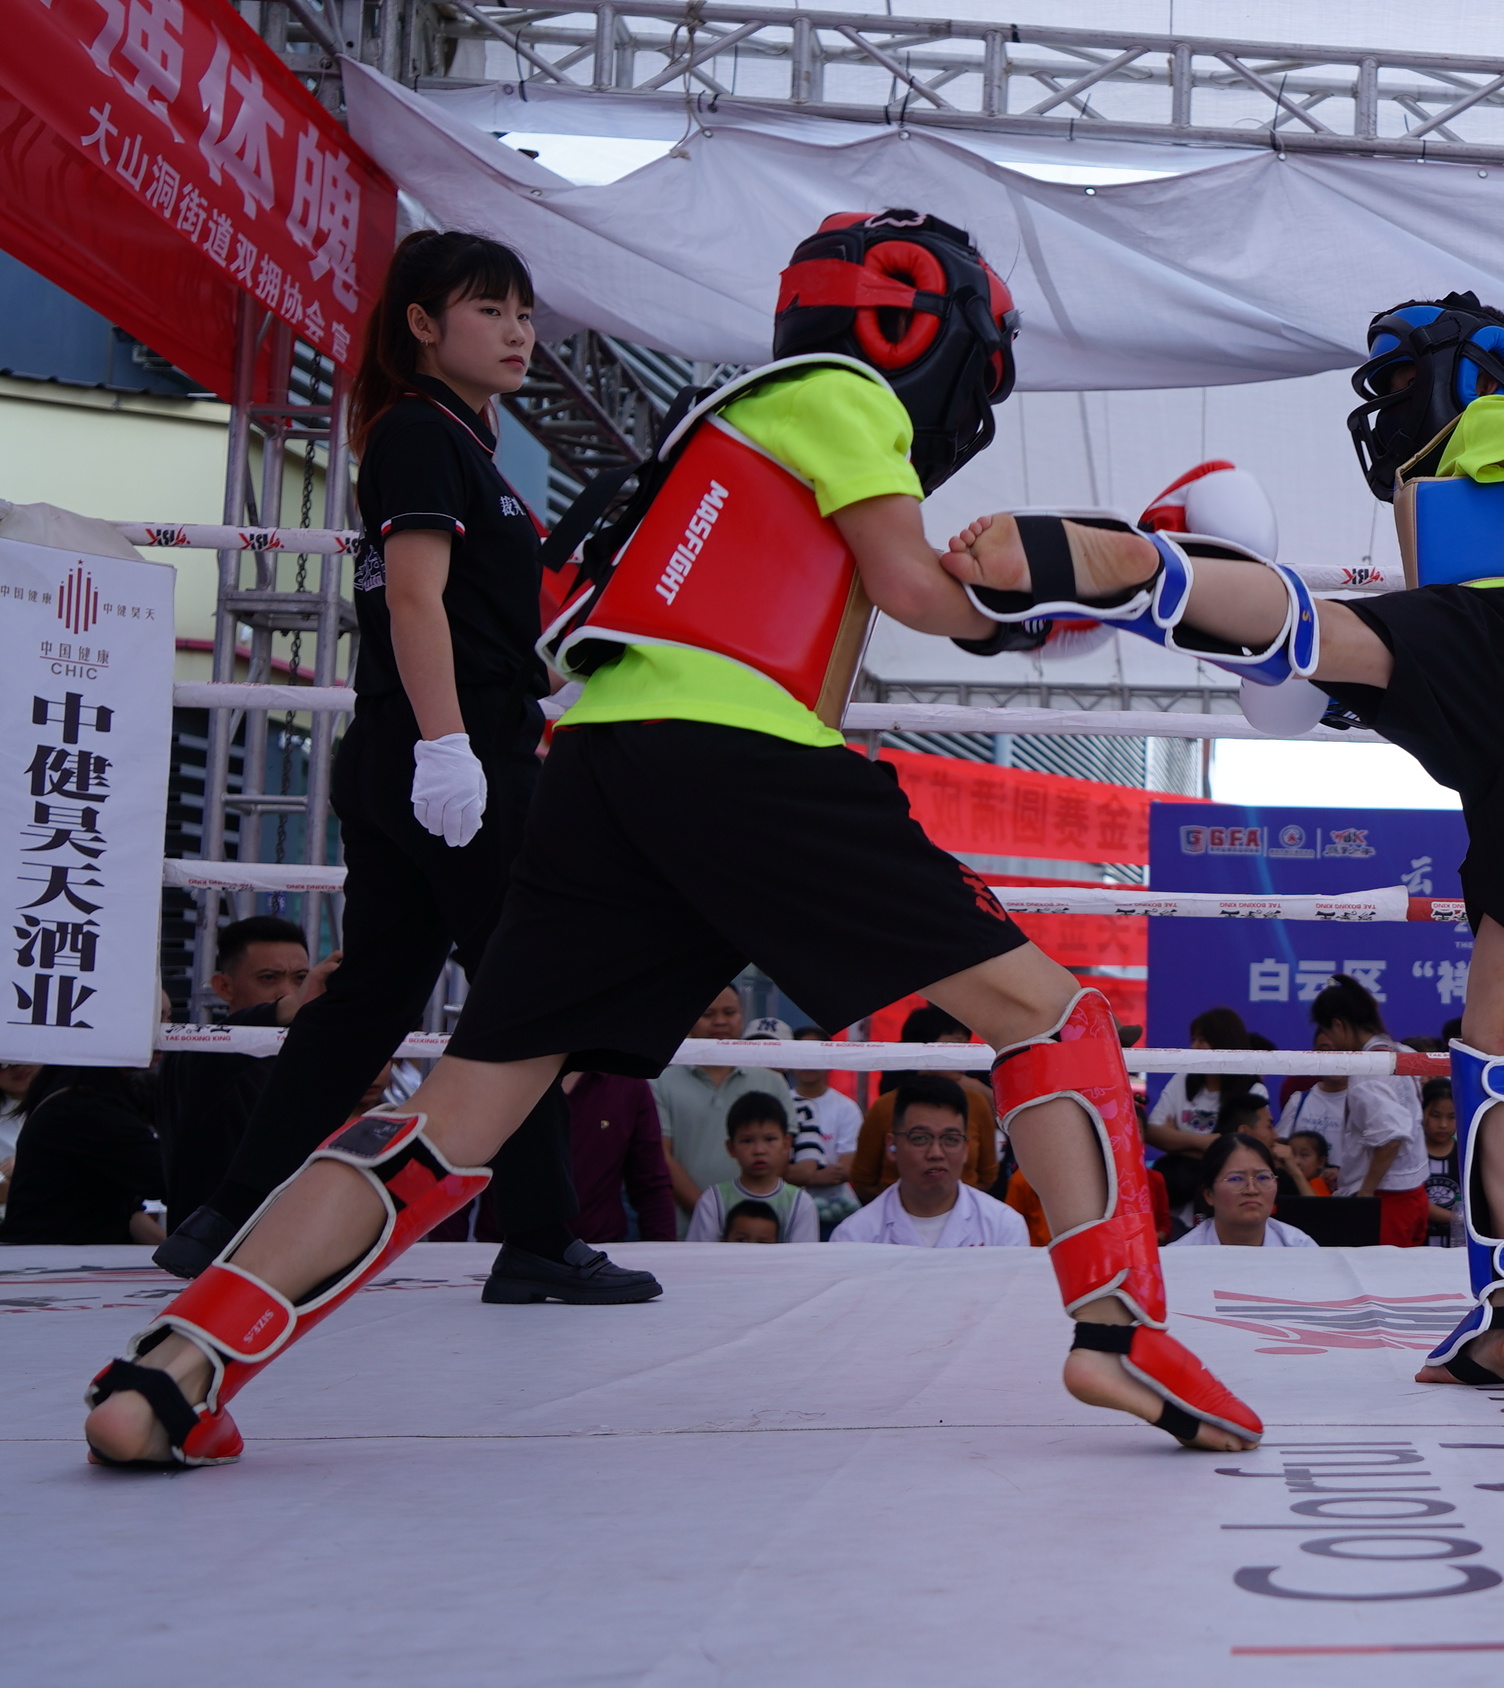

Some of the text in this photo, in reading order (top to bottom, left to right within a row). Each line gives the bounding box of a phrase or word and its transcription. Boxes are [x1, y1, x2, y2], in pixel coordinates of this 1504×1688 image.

[655, 479, 729, 606] MASFIGHT
[0, 584, 52, 605] 中国健康
[41, 640, 110, 664] 中国健康
[51, 662, 98, 680] CHIC
[8, 691, 115, 1030] 中健昊天酒业
[1249, 958, 1387, 1002] 白云区
[1214, 1441, 1503, 1601] Colorful
